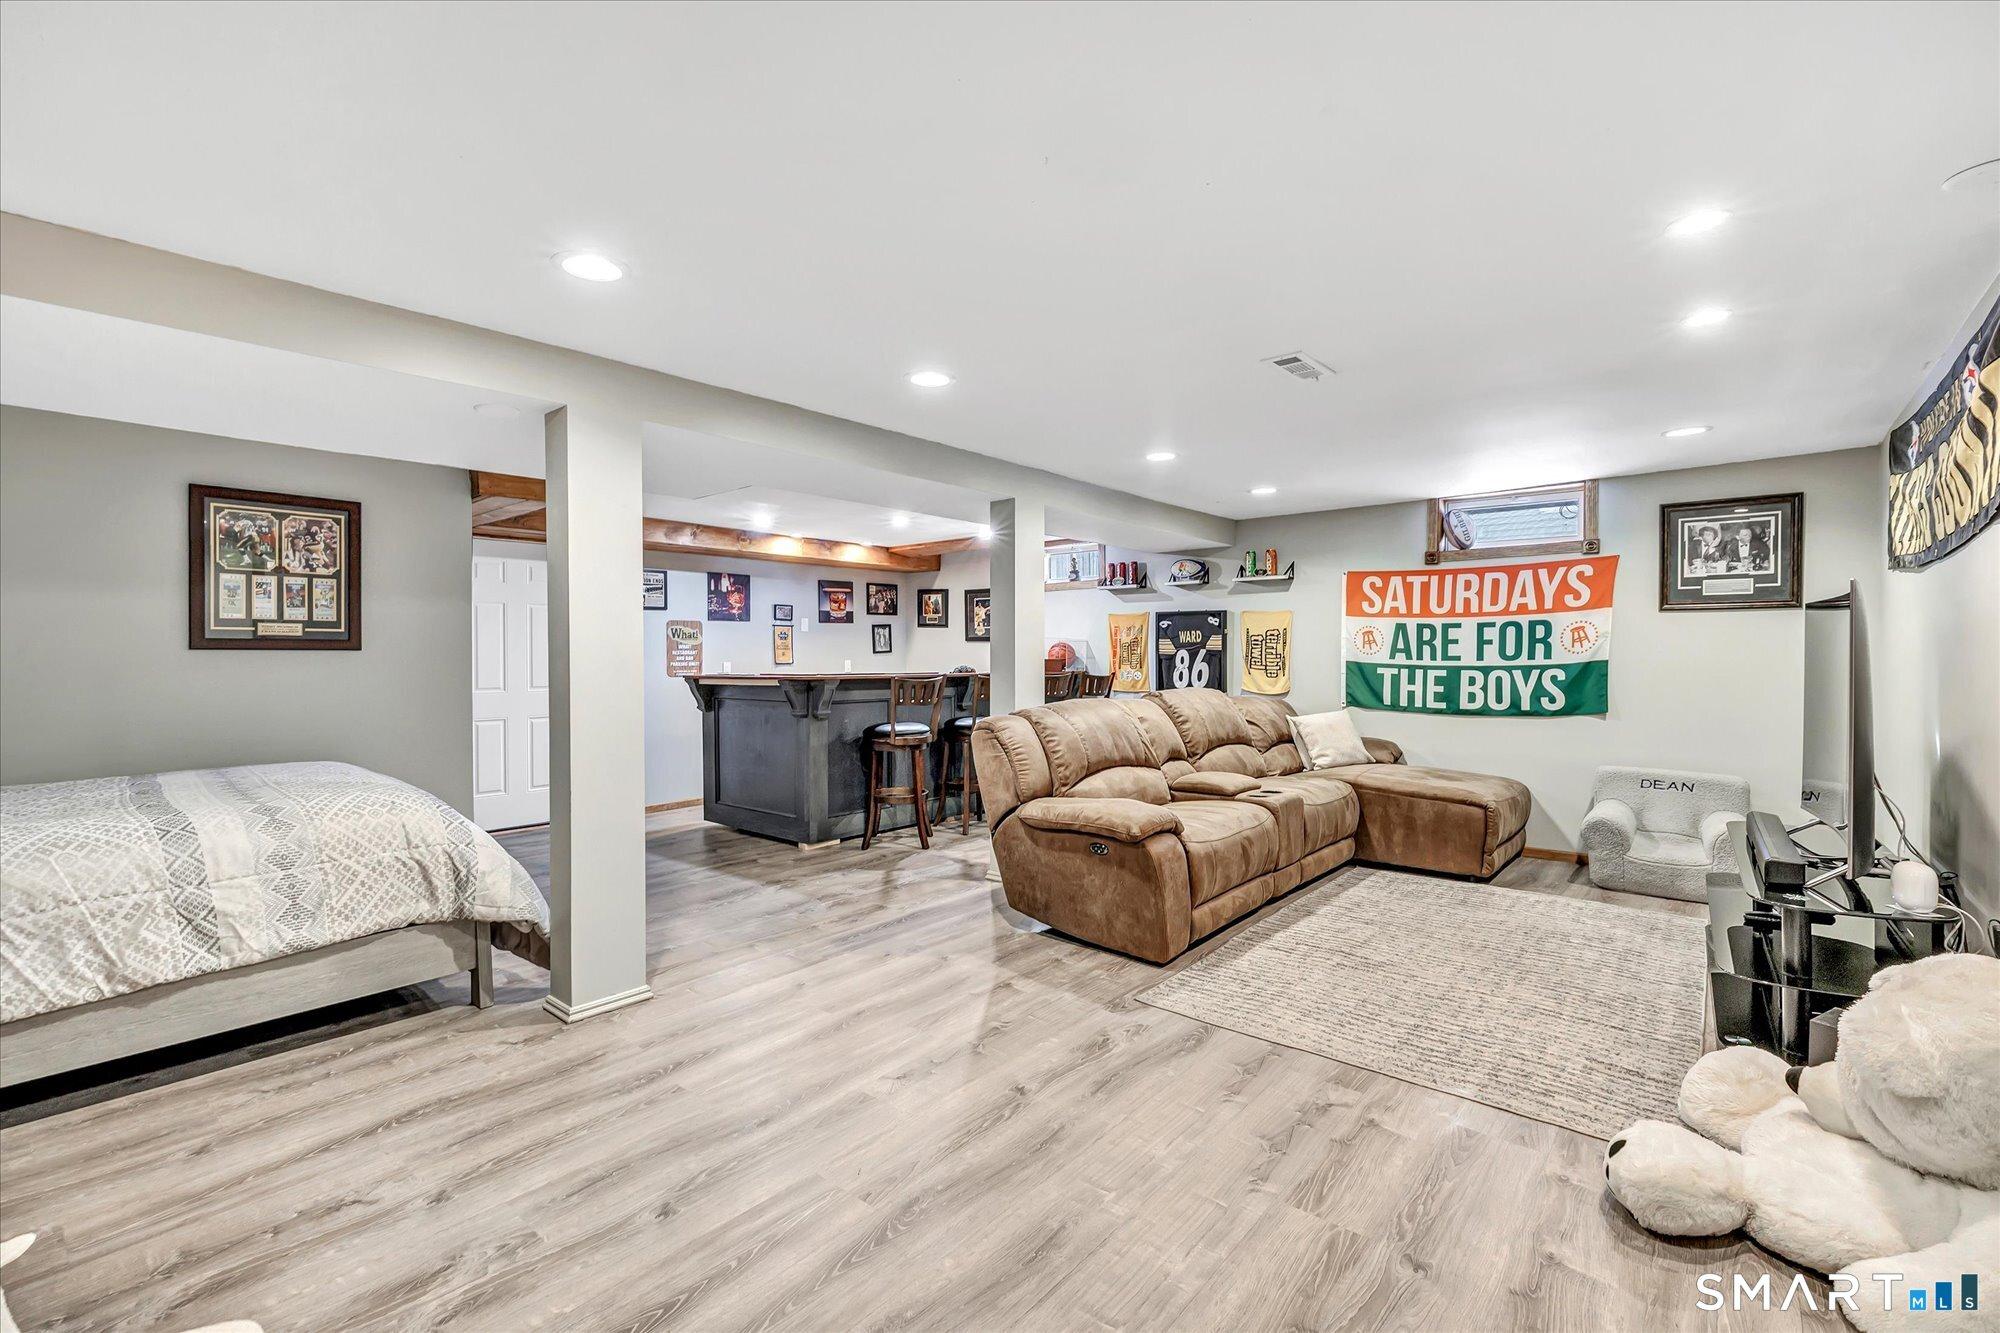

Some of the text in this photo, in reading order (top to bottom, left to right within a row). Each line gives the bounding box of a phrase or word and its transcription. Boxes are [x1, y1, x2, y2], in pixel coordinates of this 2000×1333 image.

[1453, 511, 1471, 541] GILBERT
[1361, 564, 1594, 615] SATURDAYS
[671, 628, 699, 639] What!
[1179, 630, 1202, 643] WARD
[1250, 634, 1267, 671] towel
[1388, 619, 1553, 662] ARE FOR
[1173, 648, 1209, 689] 86
[1265, 629, 1282, 678] terrible
[1377, 667, 1566, 711] THE BOYS
[1640, 779, 1695, 792] DEAN
